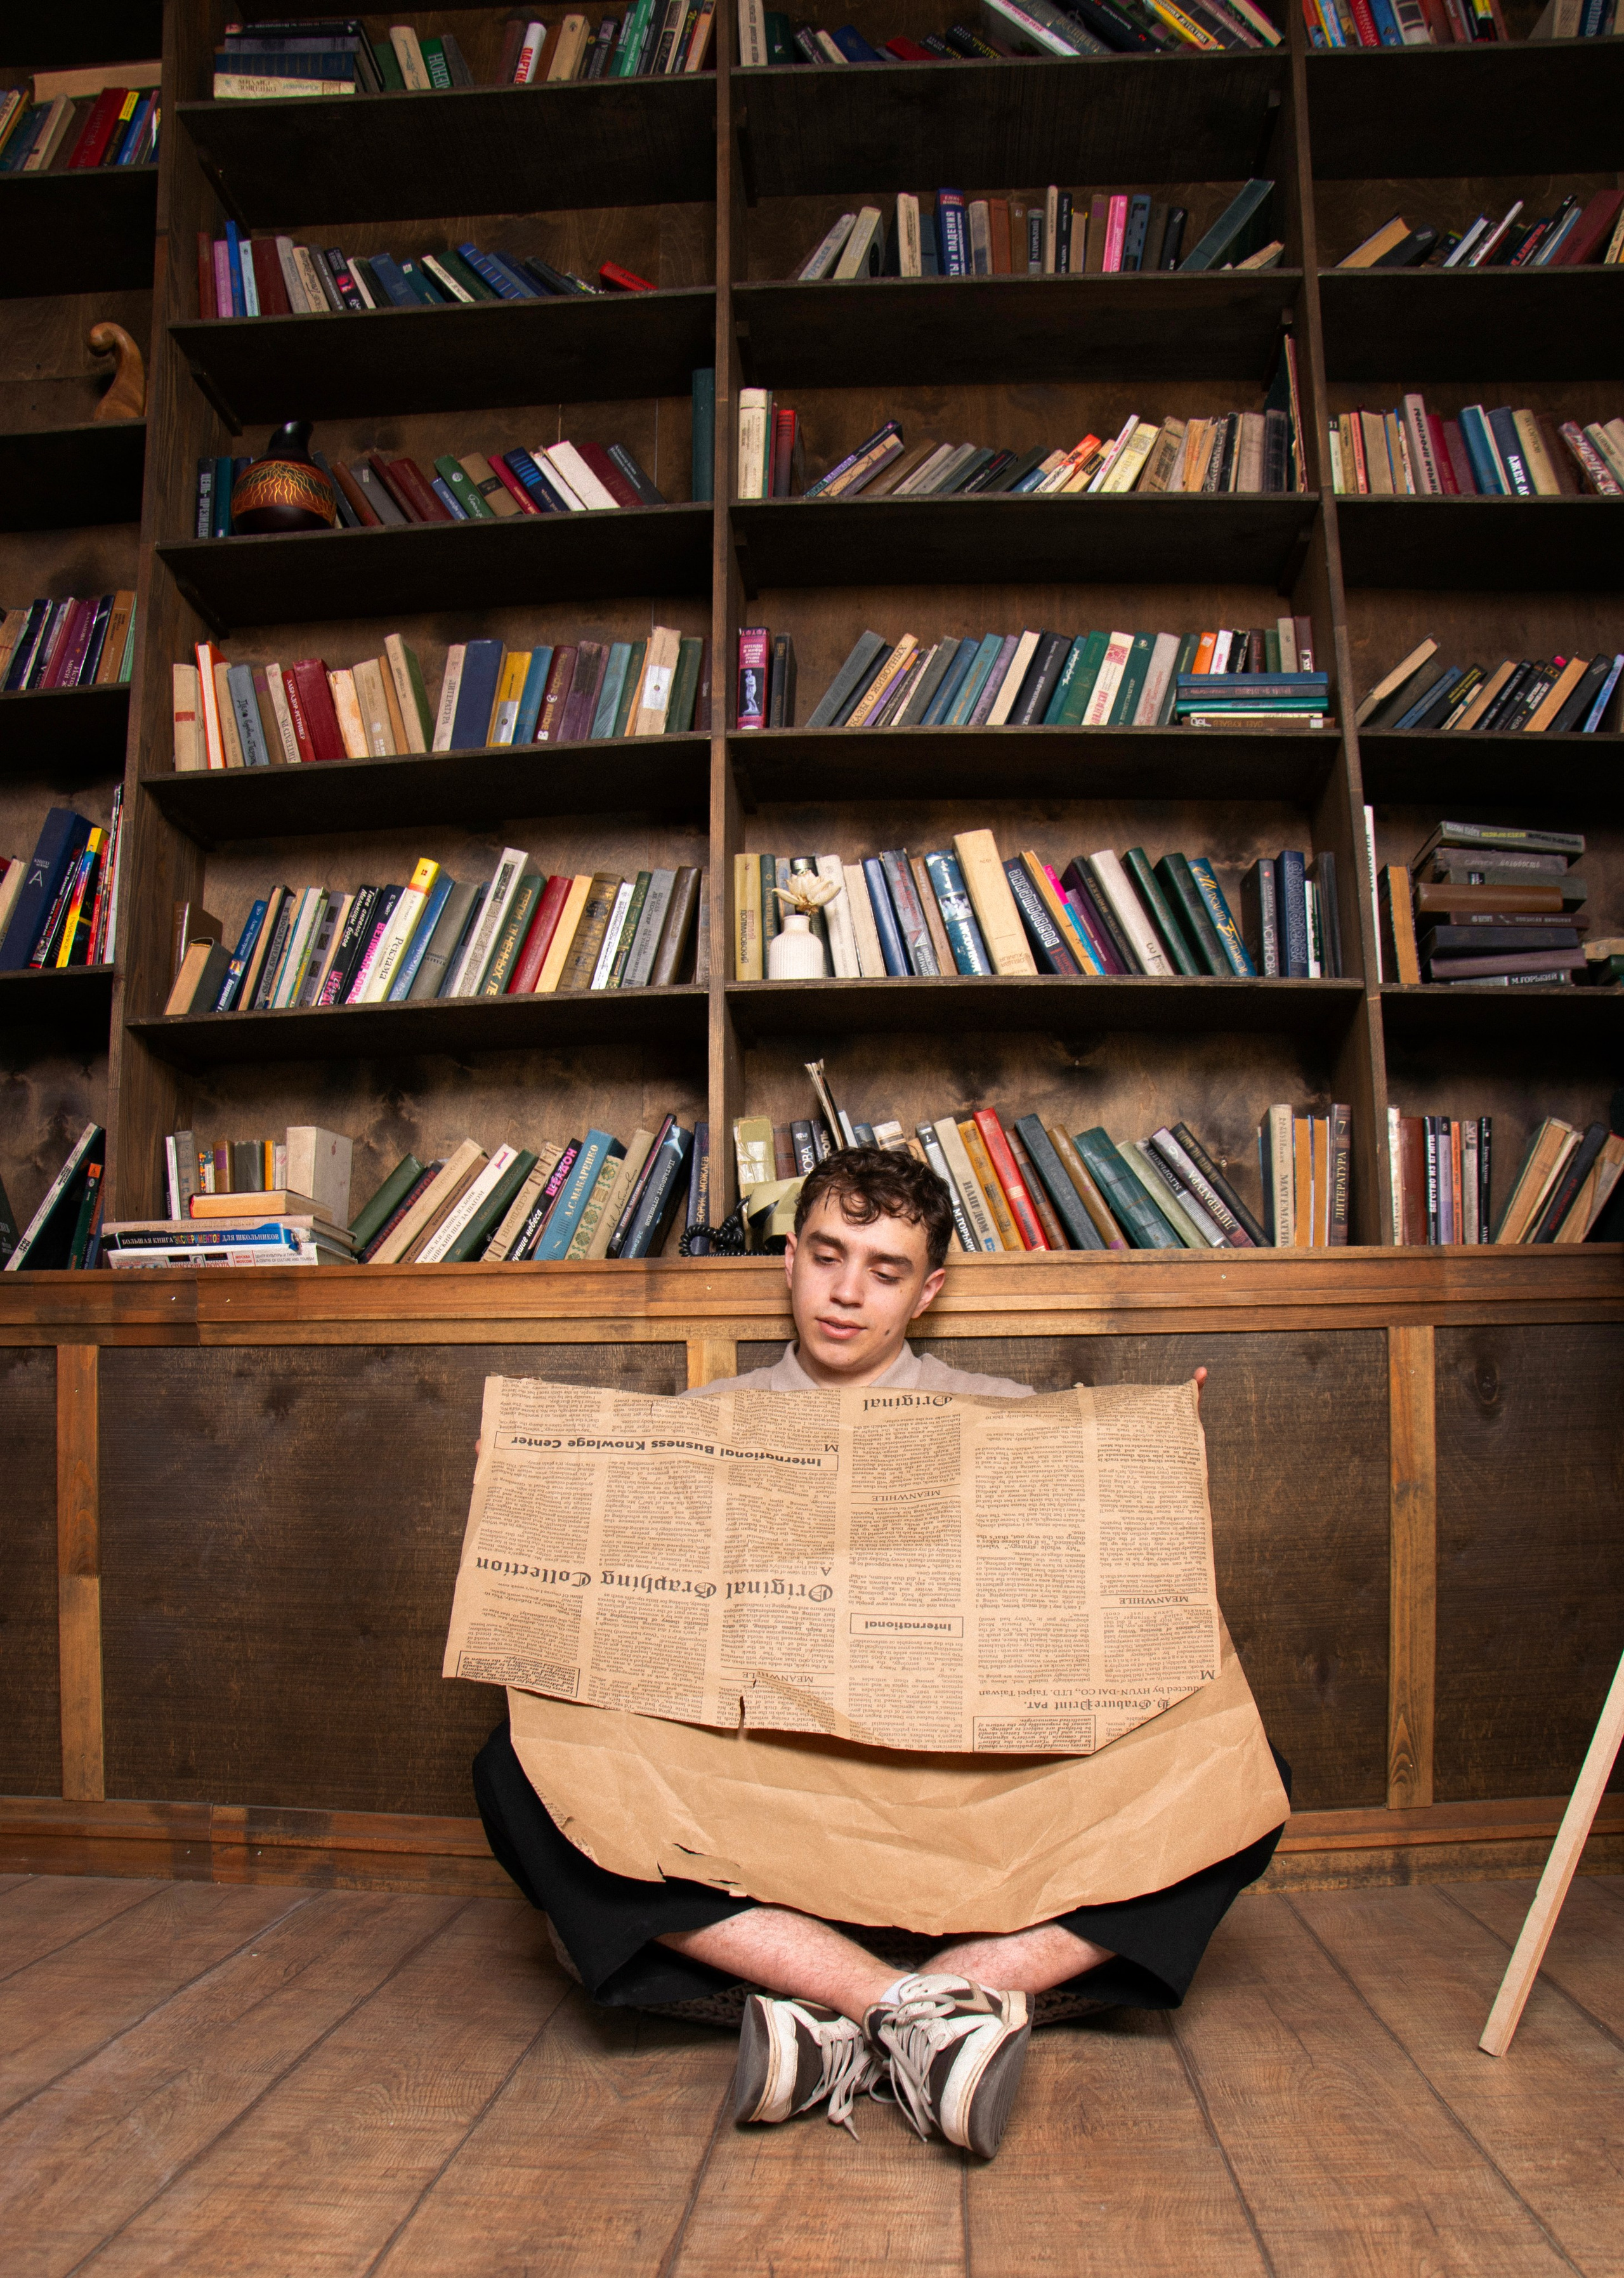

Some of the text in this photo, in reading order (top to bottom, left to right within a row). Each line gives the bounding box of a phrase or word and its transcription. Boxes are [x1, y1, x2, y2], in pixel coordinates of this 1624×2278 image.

[945, 211, 958, 251] ПАДЕНИЯ
[1412, 407, 1430, 459] ПРОСТОРЫ
[1507, 454, 1526, 485] ДЖЕК
[865, 643, 907, 702] О ЖИВОТНЫХ
[285, 678, 307, 740] ЛАБРАДОР-РЕТРИВЕР
[441, 679, 456, 725] ЛИТЕРАТУРА
[280, 718, 297, 762] ЛИТЕРАТУРА
[352, 889, 376, 937] Гнев ангелов
[383, 893, 396, 916] Е. Уайт
[644, 900, 656, 924] КОСТЕР
[1007, 867, 1059, 948] ВОЗВРАЩЕНИЕ
[1086, 877, 1108, 914] МЮНХЕН
[238, 918, 258, 956] Лэнс Армстронг
[340, 889, 369, 947] Мельницы богов
[491, 887, 533, 979] ГЕРОИ ОГНЕННЫХ
[747, 909, 756, 939] ЕВГЕНИЙ
[259, 914, 289, 993] ПОСЛЕДНЕМУ МОРЮ
[360, 920, 386, 971] ВЕЛИКАЯ
[378, 935, 405, 981] Реклама
[957, 921, 981, 973] МОПАССАН
[1262, 924, 1276, 975] УСТИНОВА
[218, 978, 235, 1007] Возвращение
[1511, 972, 1557, 984] М.ГОРЬКИЙ
[1338, 1120, 1346, 1134] 7
[1443, 1122, 1448, 1131] 8
[544, 1147, 577, 1196] ШЕЛДОН
[560, 1142, 603, 1218] А.С.МАКАРЕНКО
[655, 1158, 676, 1196] Пятьдесят
[698, 1156, 709, 1192] МОЖАЕВ
[1146, 1148, 1182, 1191] М.ГОРЬКИЙ
[1334, 1151, 1346, 1220] ЛИТЕРАТУРА
[1427, 1134, 1437, 1212] БЕГСТВО ИЗ ЕГИПТА
[449, 1189, 485, 1234] ШАГ ЗА ШАГОМ
[643, 1195, 660, 1227] оттенков
[962, 1179, 990, 1234] НАШ ДОМ
[1186, 1170, 1236, 1231] ЛИТЕРАТУРА
[175, 1233, 219, 1245] ЭКСПЕРИМЕНТОВ
[236, 1233, 279, 1241] ШКОЛЬНИКОВ
[522, 1208, 544, 1236] небеса
[863, 1394, 952, 1411] Original
[511, 1436, 821, 1466] International Busness Knowlage Center
[872, 1490, 940, 1501] MEANWHILE
[476, 1557, 833, 1602] Original Graphing Collection
[865, 1621, 952, 1631] International
[1018, 1687, 1048, 1696] Taipei
[1050, 1688, 1072, 1696] LTD.
[1075, 1687, 1095, 1696] CO.,
[1099, 1687, 1150, 1696] HYUN-DAI
[1153, 1686, 1164, 1694] by
